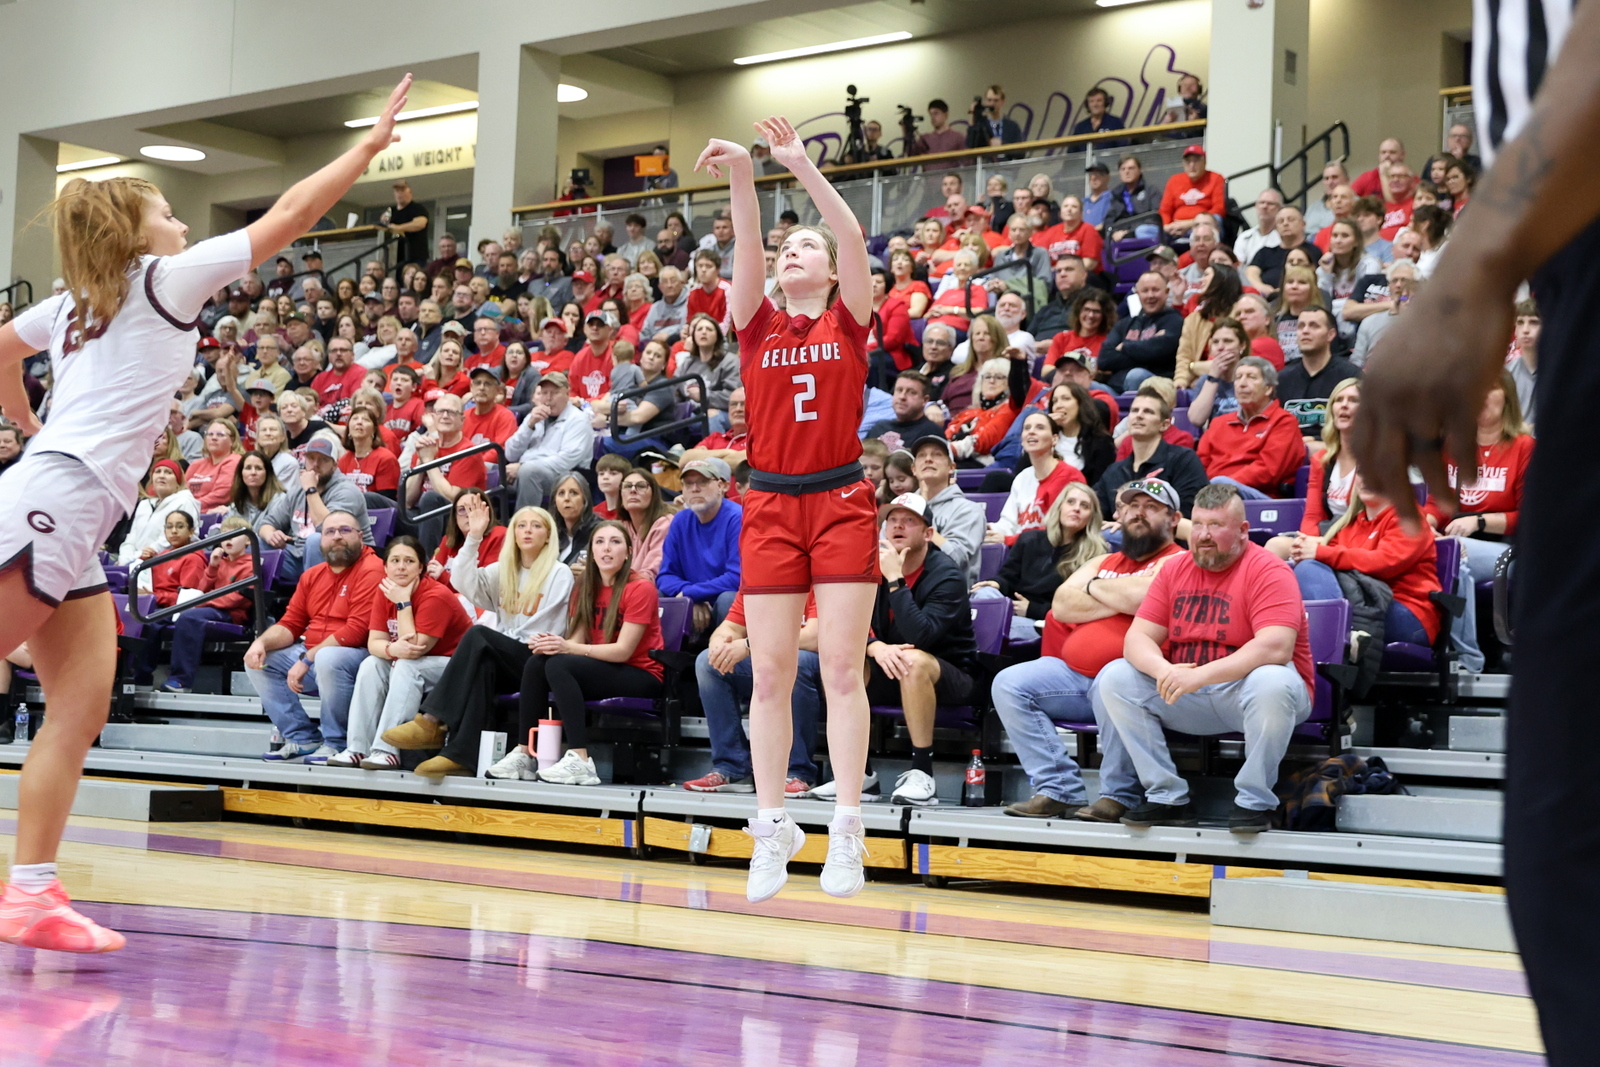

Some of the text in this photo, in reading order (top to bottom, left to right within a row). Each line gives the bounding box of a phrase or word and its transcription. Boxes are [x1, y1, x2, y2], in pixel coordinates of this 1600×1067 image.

[379, 156, 404, 173] AND
[412, 146, 462, 167] WEIGHT
[761, 342, 841, 369] BELLEVUE
[791, 373, 818, 423] 2
[26, 509, 57, 534] G
[1173, 594, 1230, 625] STATE
